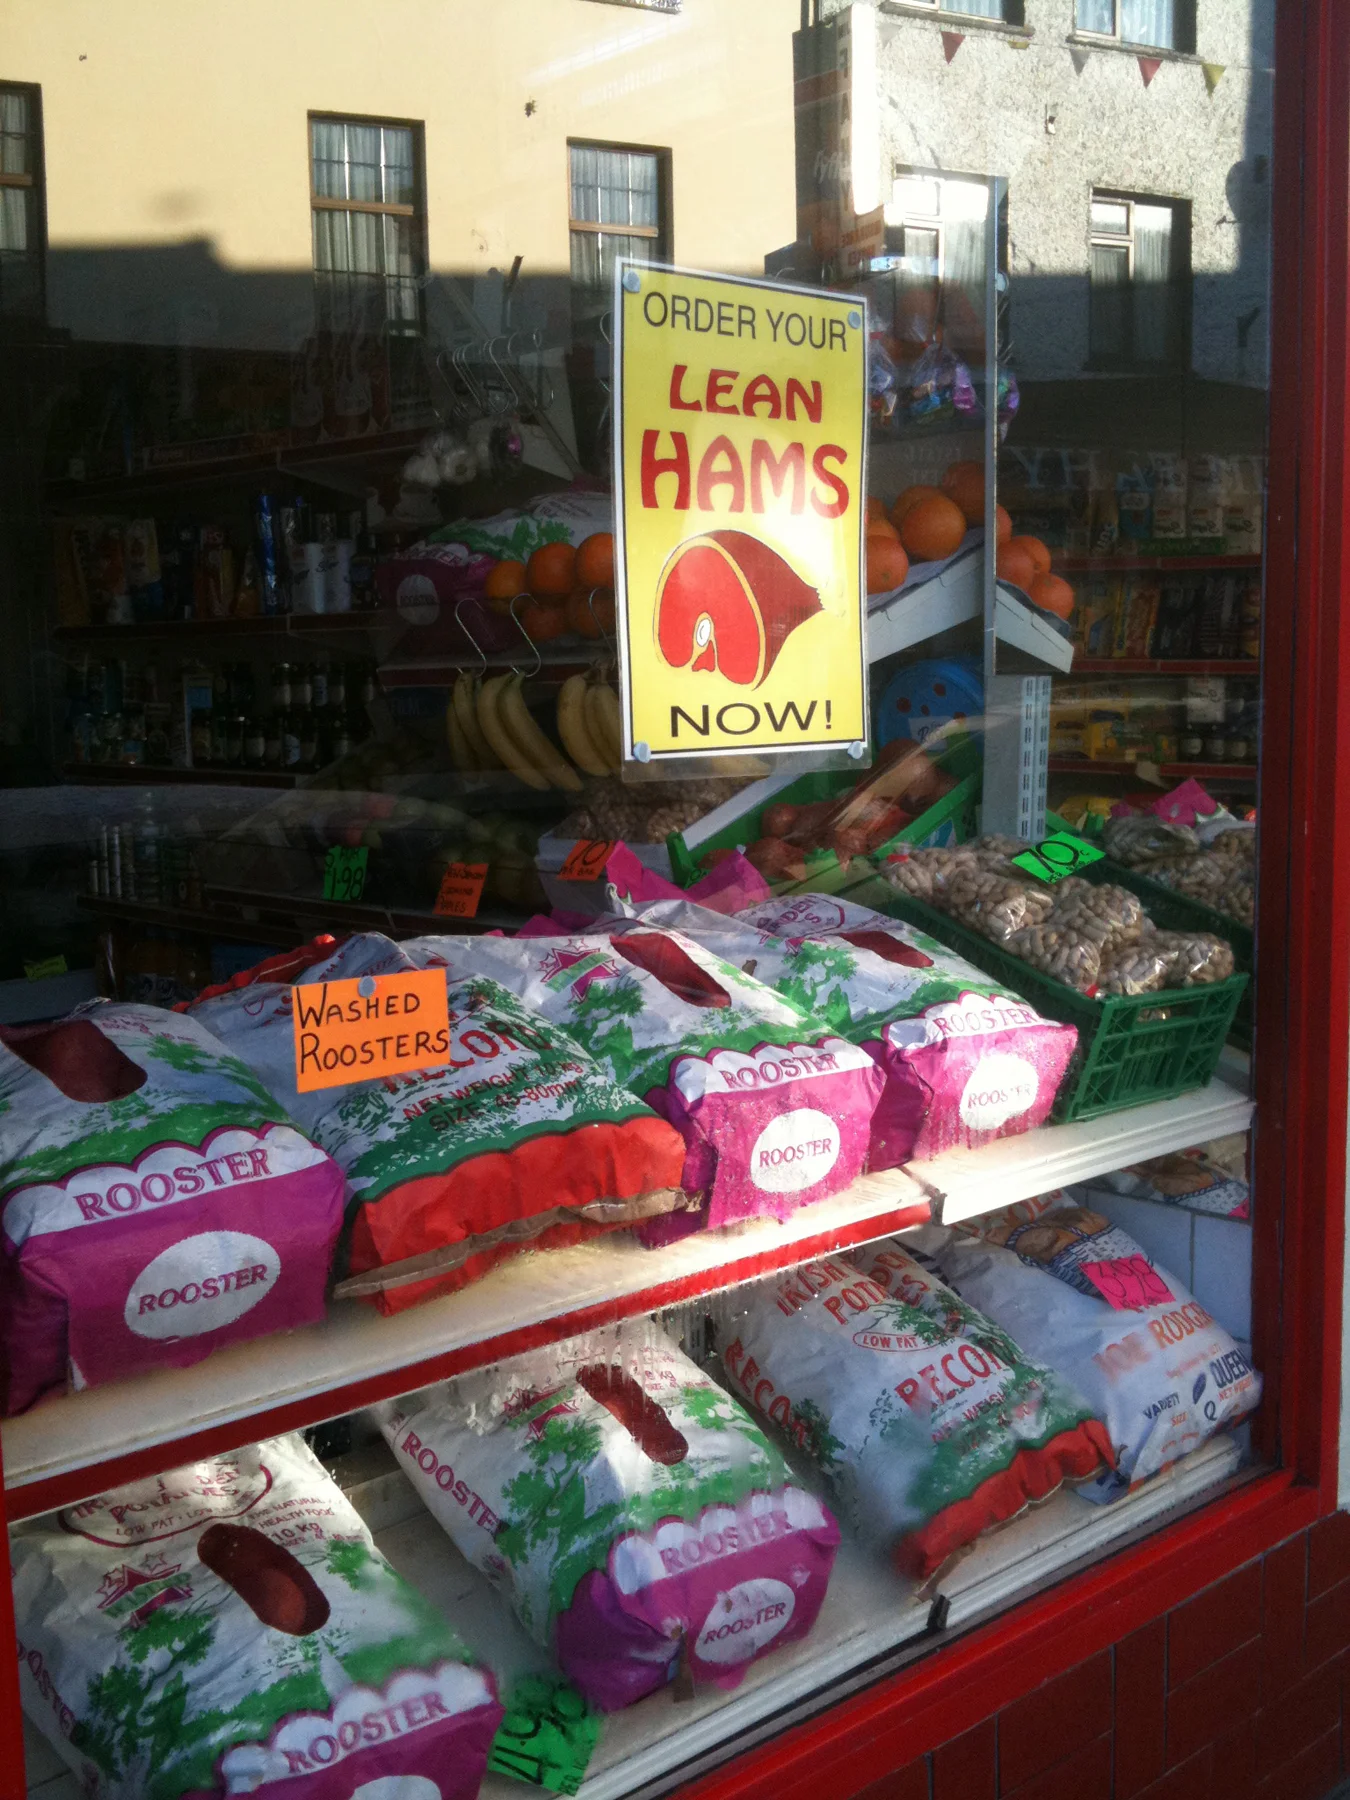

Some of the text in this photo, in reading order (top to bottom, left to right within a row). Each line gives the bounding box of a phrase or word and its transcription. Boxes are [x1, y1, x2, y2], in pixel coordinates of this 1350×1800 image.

[643, 291, 848, 352] ORDER YOUR
[669, 364, 823, 423] LEAN
[641, 429, 850, 519] HAMS
[670, 699, 832, 738] NOW!
[330, 866, 364, 901] 1.98
[296, 983, 420, 1029] WASHED
[933, 1008, 1040, 1037] ROOSTER
[300, 1029, 449, 1074] ROOSTERS
[719, 1053, 840, 1089] ROOSTER
[402, 1093, 444, 1121] NET
[449, 1066, 531, 1101] WEIGHT
[758, 1137, 832, 1168] ROOSTER
[73, 1148, 272, 1221] ROOSTER
[137, 1263, 268, 1315] ROOSTER
[863, 1333, 919, 1349] LOW FAT
[894, 1340, 1003, 1414] RECO
[1143, 1391, 1181, 1420] VARIETY
[258, 1508, 305, 1529] HEALTH
[660, 1509, 792, 1574] ROOSTER
[703, 1602, 786, 1645] ROOSTER
[281, 1691, 451, 1774] ROOSTER
